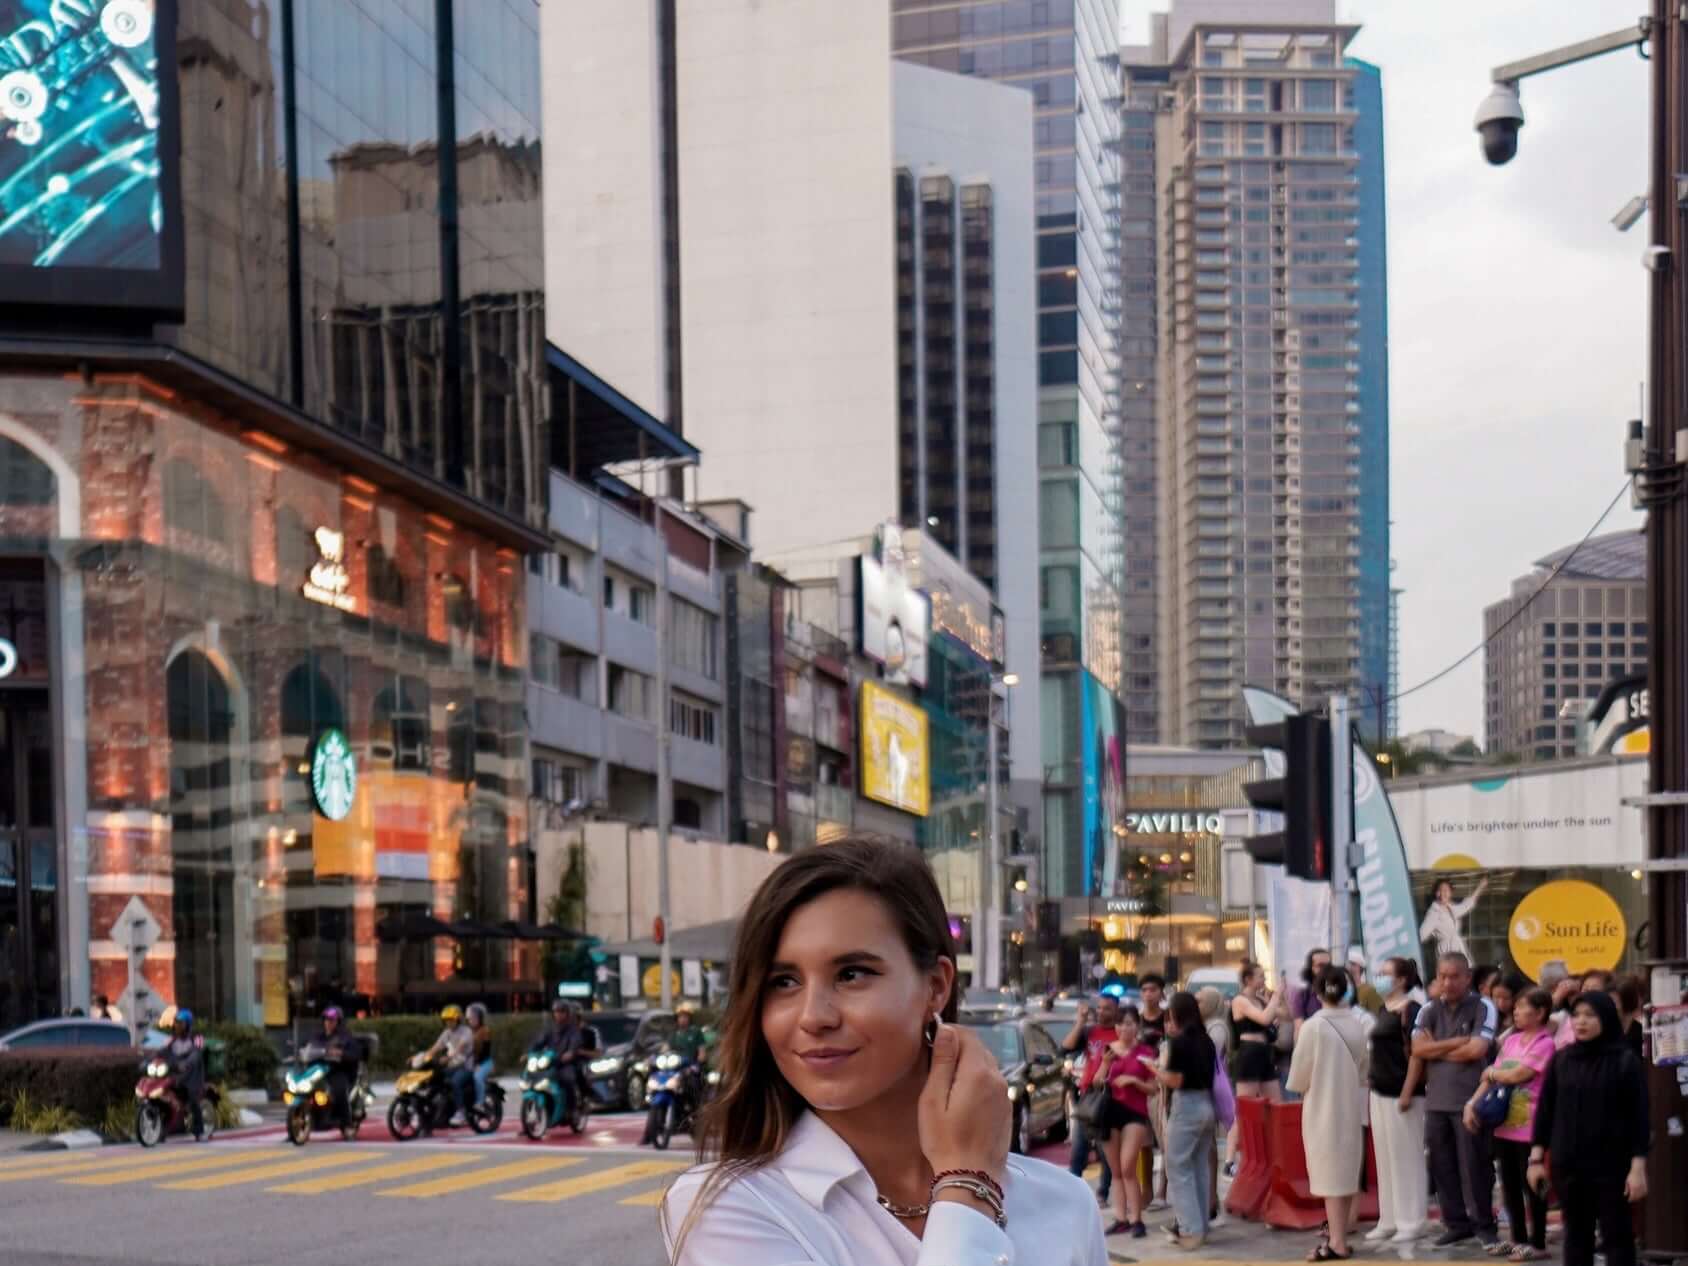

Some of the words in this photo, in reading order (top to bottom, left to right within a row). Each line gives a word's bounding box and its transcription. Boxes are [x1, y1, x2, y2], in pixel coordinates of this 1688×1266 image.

[1430, 822, 1463, 833] Life's
[1467, 820, 1520, 834] brighter
[1522, 818, 1559, 830] under
[1564, 816, 1585, 827] the
[1589, 816, 1612, 826] sun
[1544, 921, 1580, 937] Sun
[1585, 921, 1618, 937] Life
